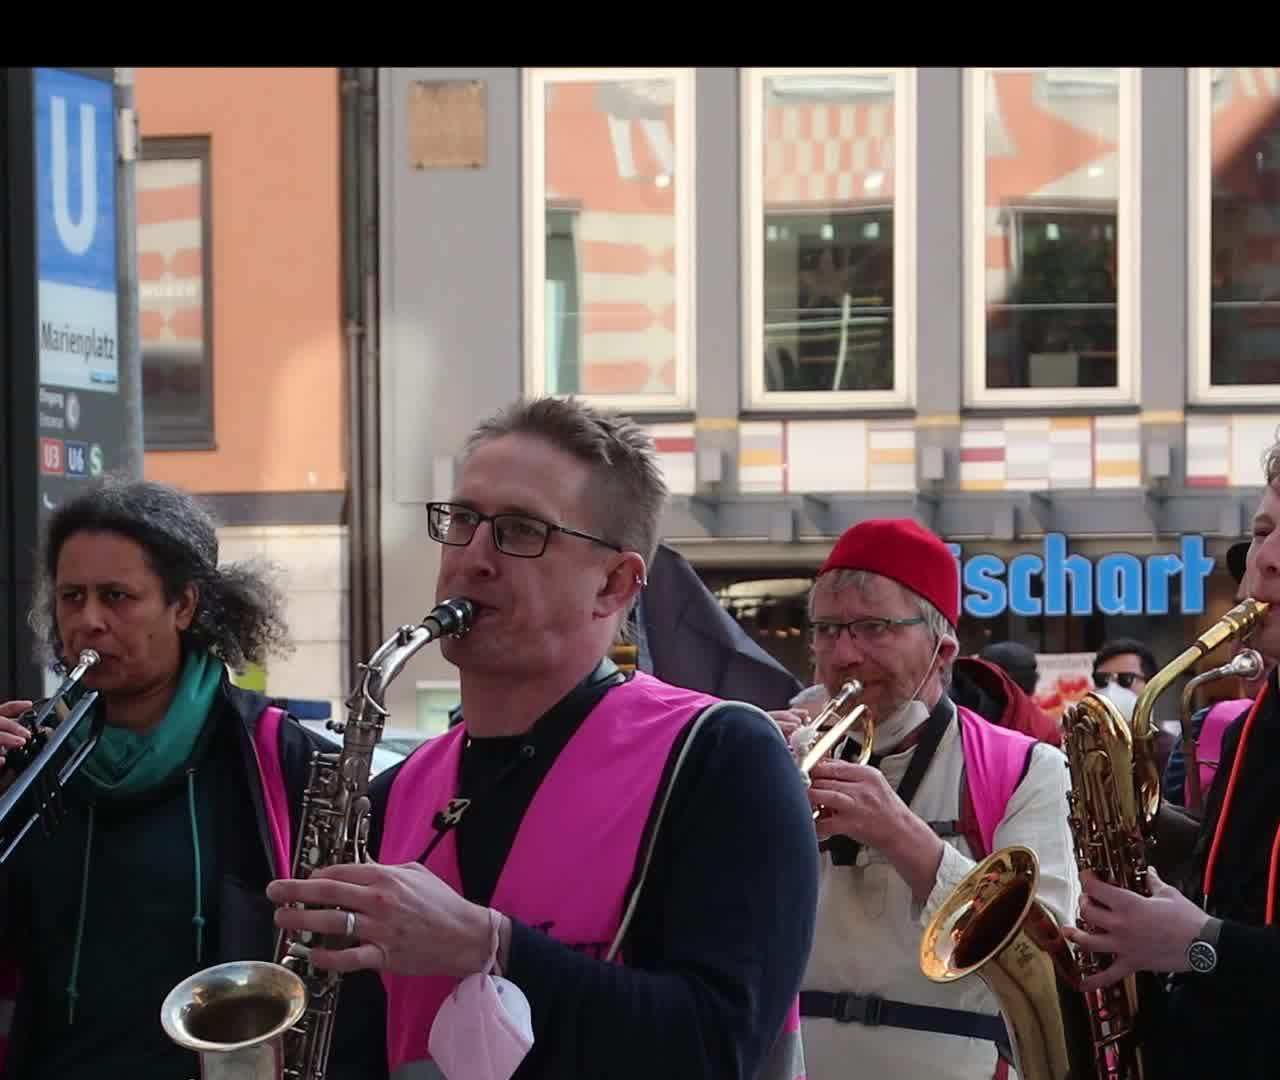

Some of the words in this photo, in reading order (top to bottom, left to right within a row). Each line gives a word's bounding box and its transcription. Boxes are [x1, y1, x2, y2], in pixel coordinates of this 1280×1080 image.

[50, 95, 97, 256] U
[40, 320, 114, 365] Marienplatz
[44, 443, 60, 469] U3
[67, 446, 85, 473] U6
[88, 443, 103, 476] S
[948, 531, 1216, 618] schart
